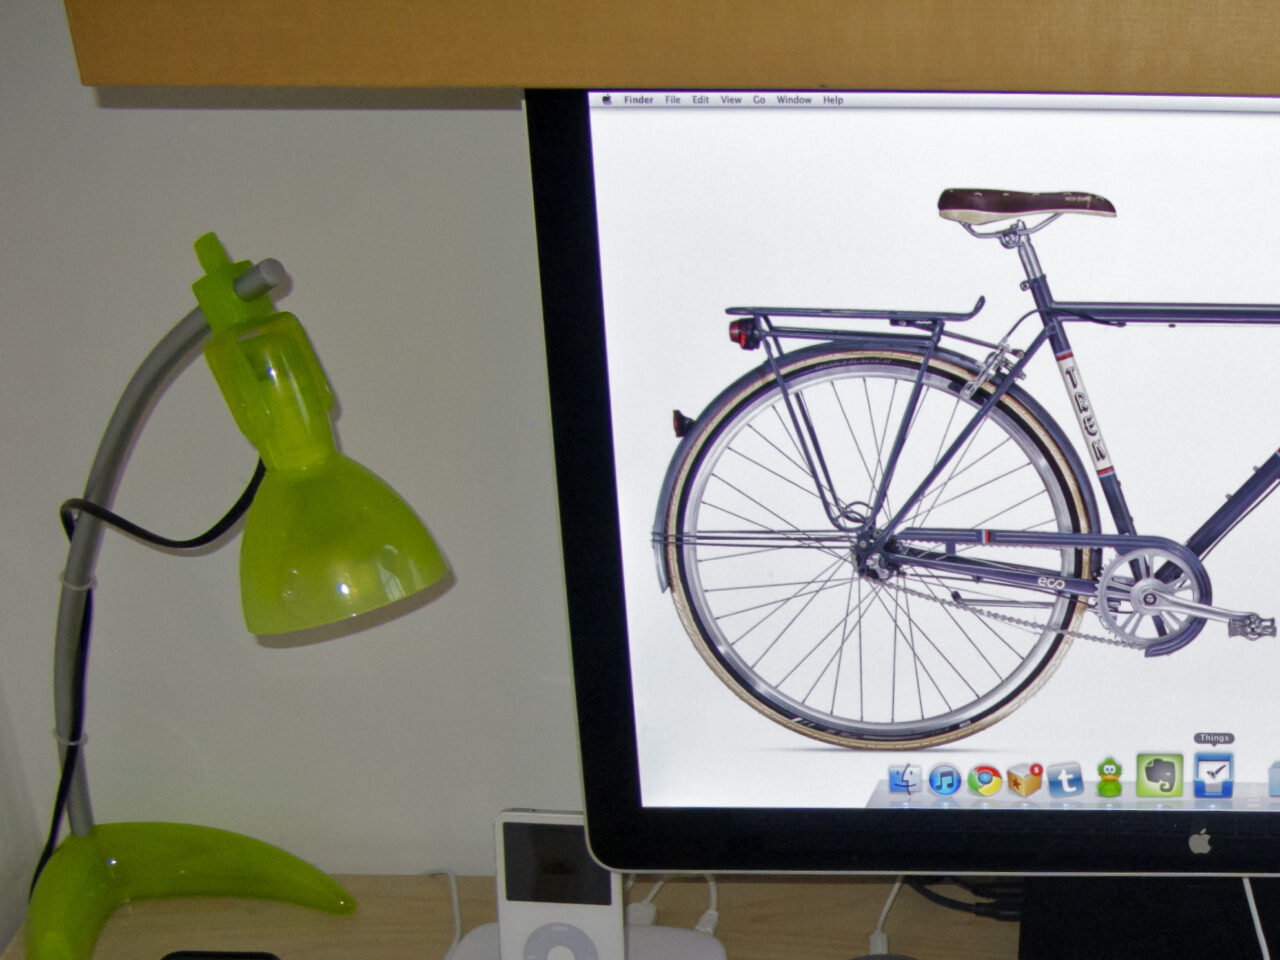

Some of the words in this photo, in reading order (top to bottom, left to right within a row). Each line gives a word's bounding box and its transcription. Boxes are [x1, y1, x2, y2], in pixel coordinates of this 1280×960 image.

[624, 96, 654, 105] Finder
[665, 96, 681, 105] File
[692, 96, 710, 105] Edit
[720, 96, 742, 105] View
[753, 96, 766, 105] Go
[777, 96, 812, 105] Window
[823, 96, 844, 106] Help
[1065, 366, 1106, 462] TREK
[1037, 577, 1066, 590] eco
[1200, 733, 1230, 743] Things
[1058, 768, 1077, 793] t
